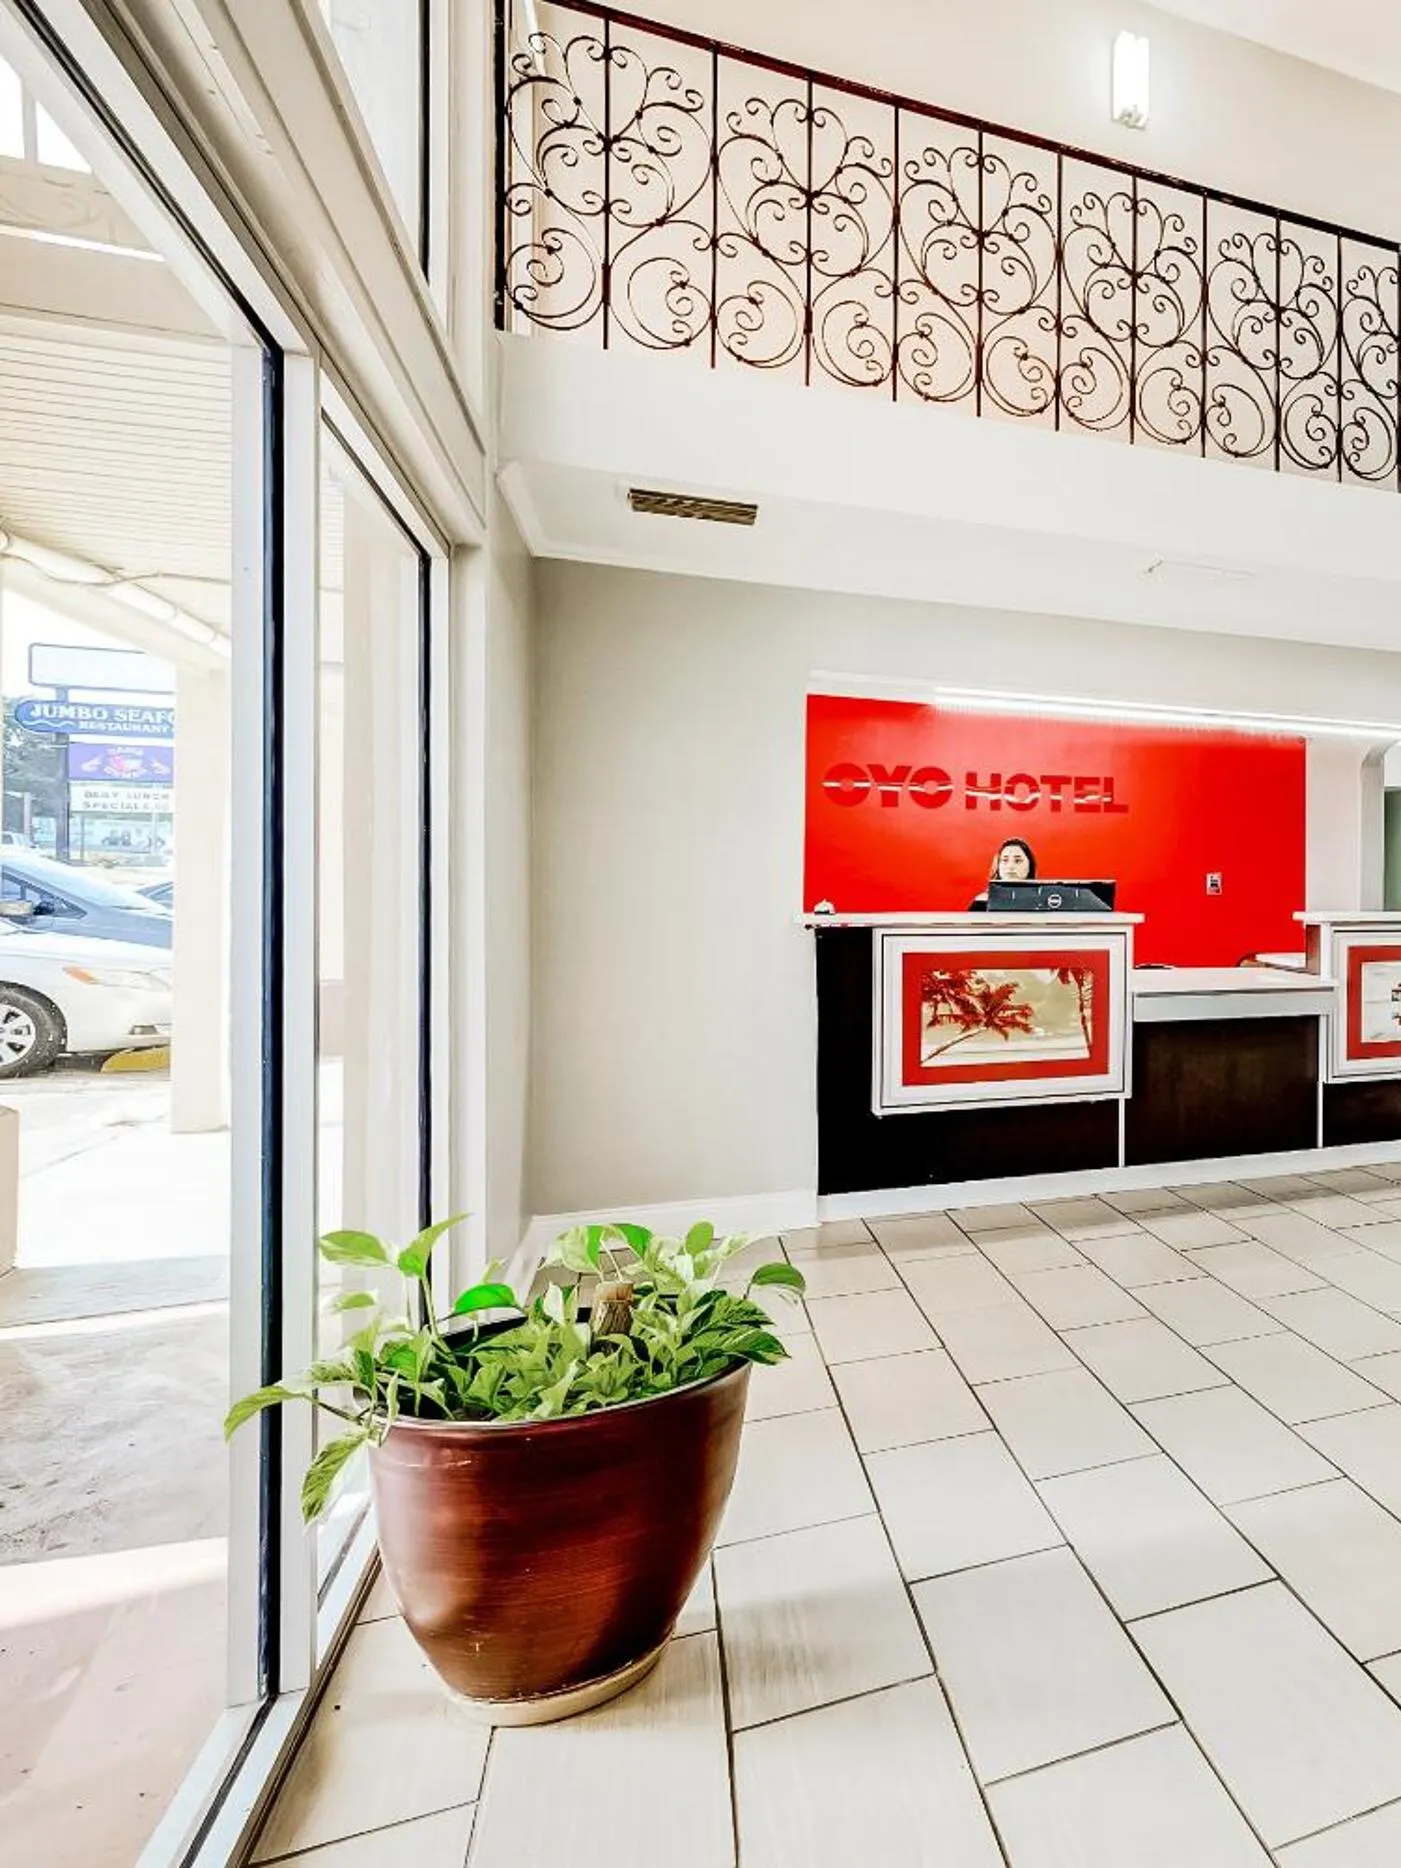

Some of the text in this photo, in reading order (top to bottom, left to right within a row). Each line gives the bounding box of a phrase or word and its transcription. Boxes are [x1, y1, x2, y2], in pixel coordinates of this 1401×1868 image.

[29, 703, 108, 720] JUMBO
[822, 762, 1129, 814] OYO HOTEL
